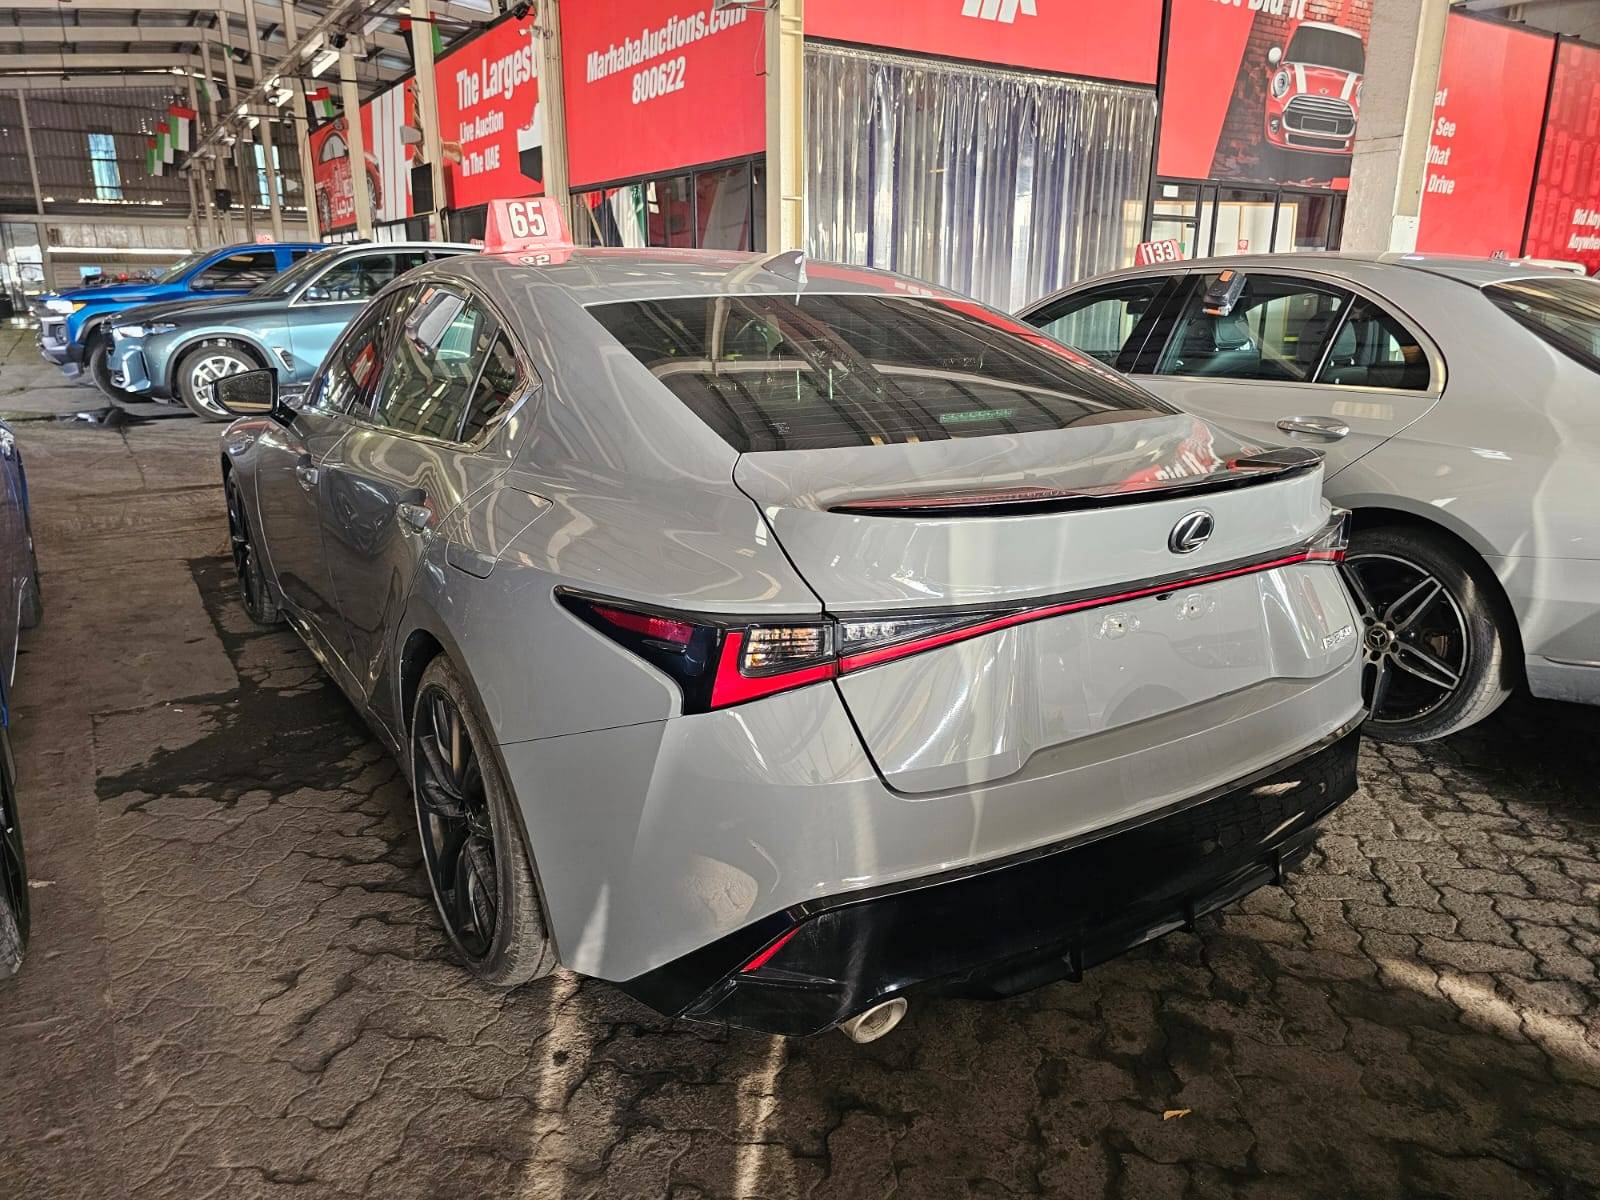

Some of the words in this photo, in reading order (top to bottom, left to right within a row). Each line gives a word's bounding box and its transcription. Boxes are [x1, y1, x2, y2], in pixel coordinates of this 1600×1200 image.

[456, 68, 479, 110] The
[482, 40, 539, 100] Largest
[632, 56, 686, 104] 800622
[460, 121, 474, 144] Live
[475, 110, 504, 139] Auction
[1435, 116, 1456, 138] See
[462, 157, 470, 177] In
[470, 152, 484, 173] The
[485, 144, 500, 171] UAE
[1427, 174, 1455, 195] Drive
[508, 201, 546, 238] 65
[1572, 208, 1588, 225] Bid
[1145, 240, 1176, 265] 133
